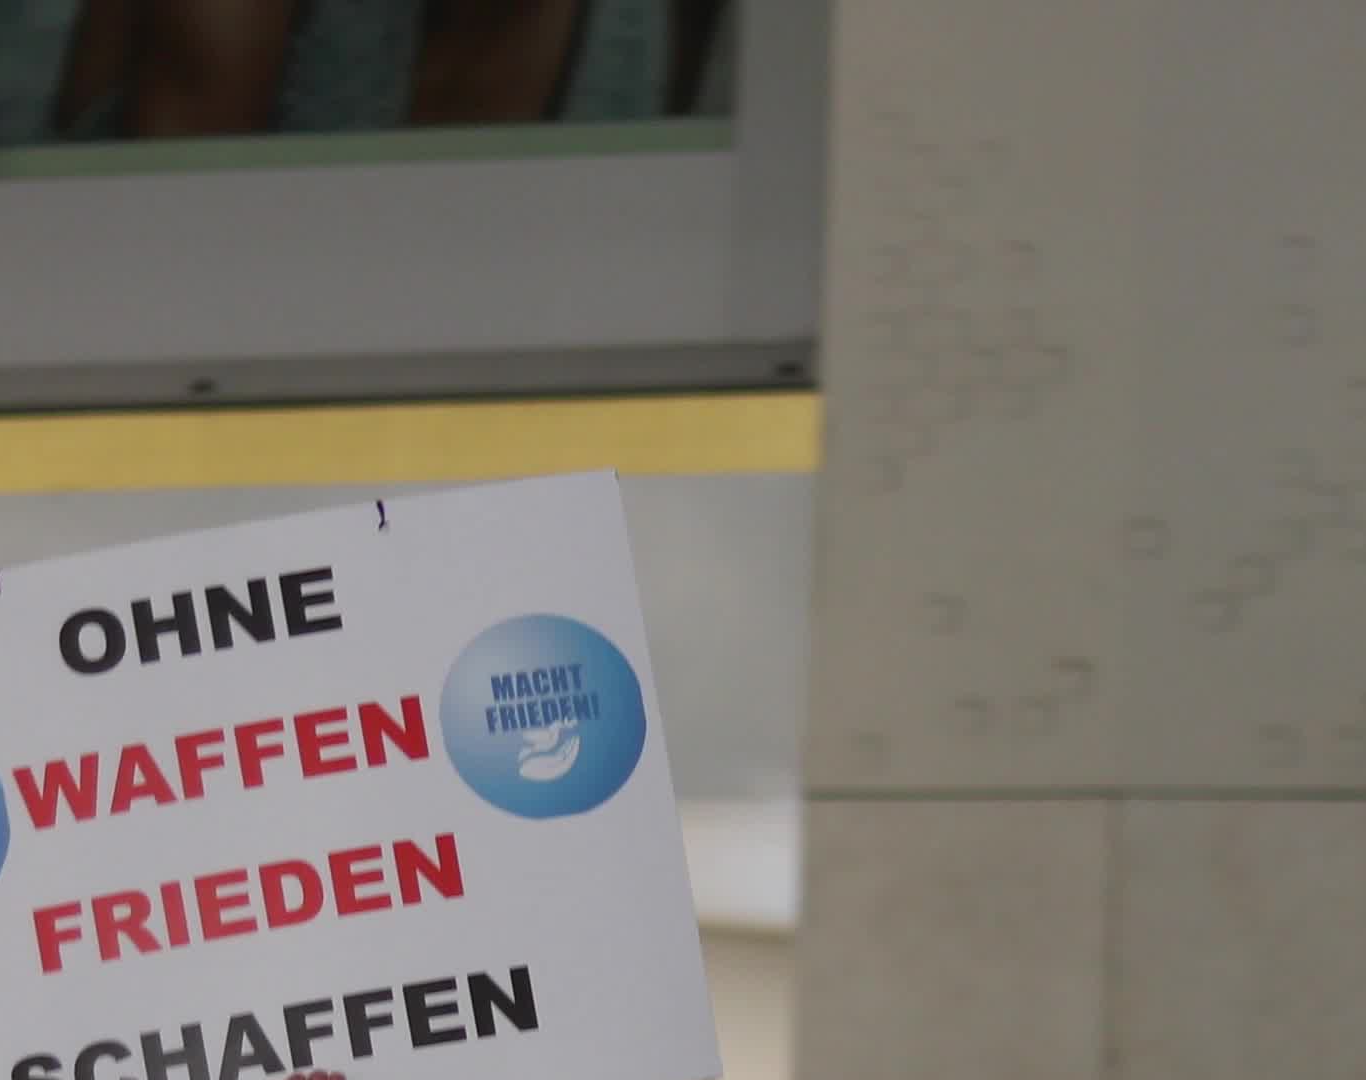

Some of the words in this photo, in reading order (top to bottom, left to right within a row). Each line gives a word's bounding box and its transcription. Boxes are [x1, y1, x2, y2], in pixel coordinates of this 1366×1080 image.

[58, 566, 343, 675] OHNE
[485, 692, 601, 736] FRIEDEN!
[491, 664, 582, 702] MACHT
[12, 695, 430, 828] WAFFEN
[33, 833, 465, 974] FRIEDEN
